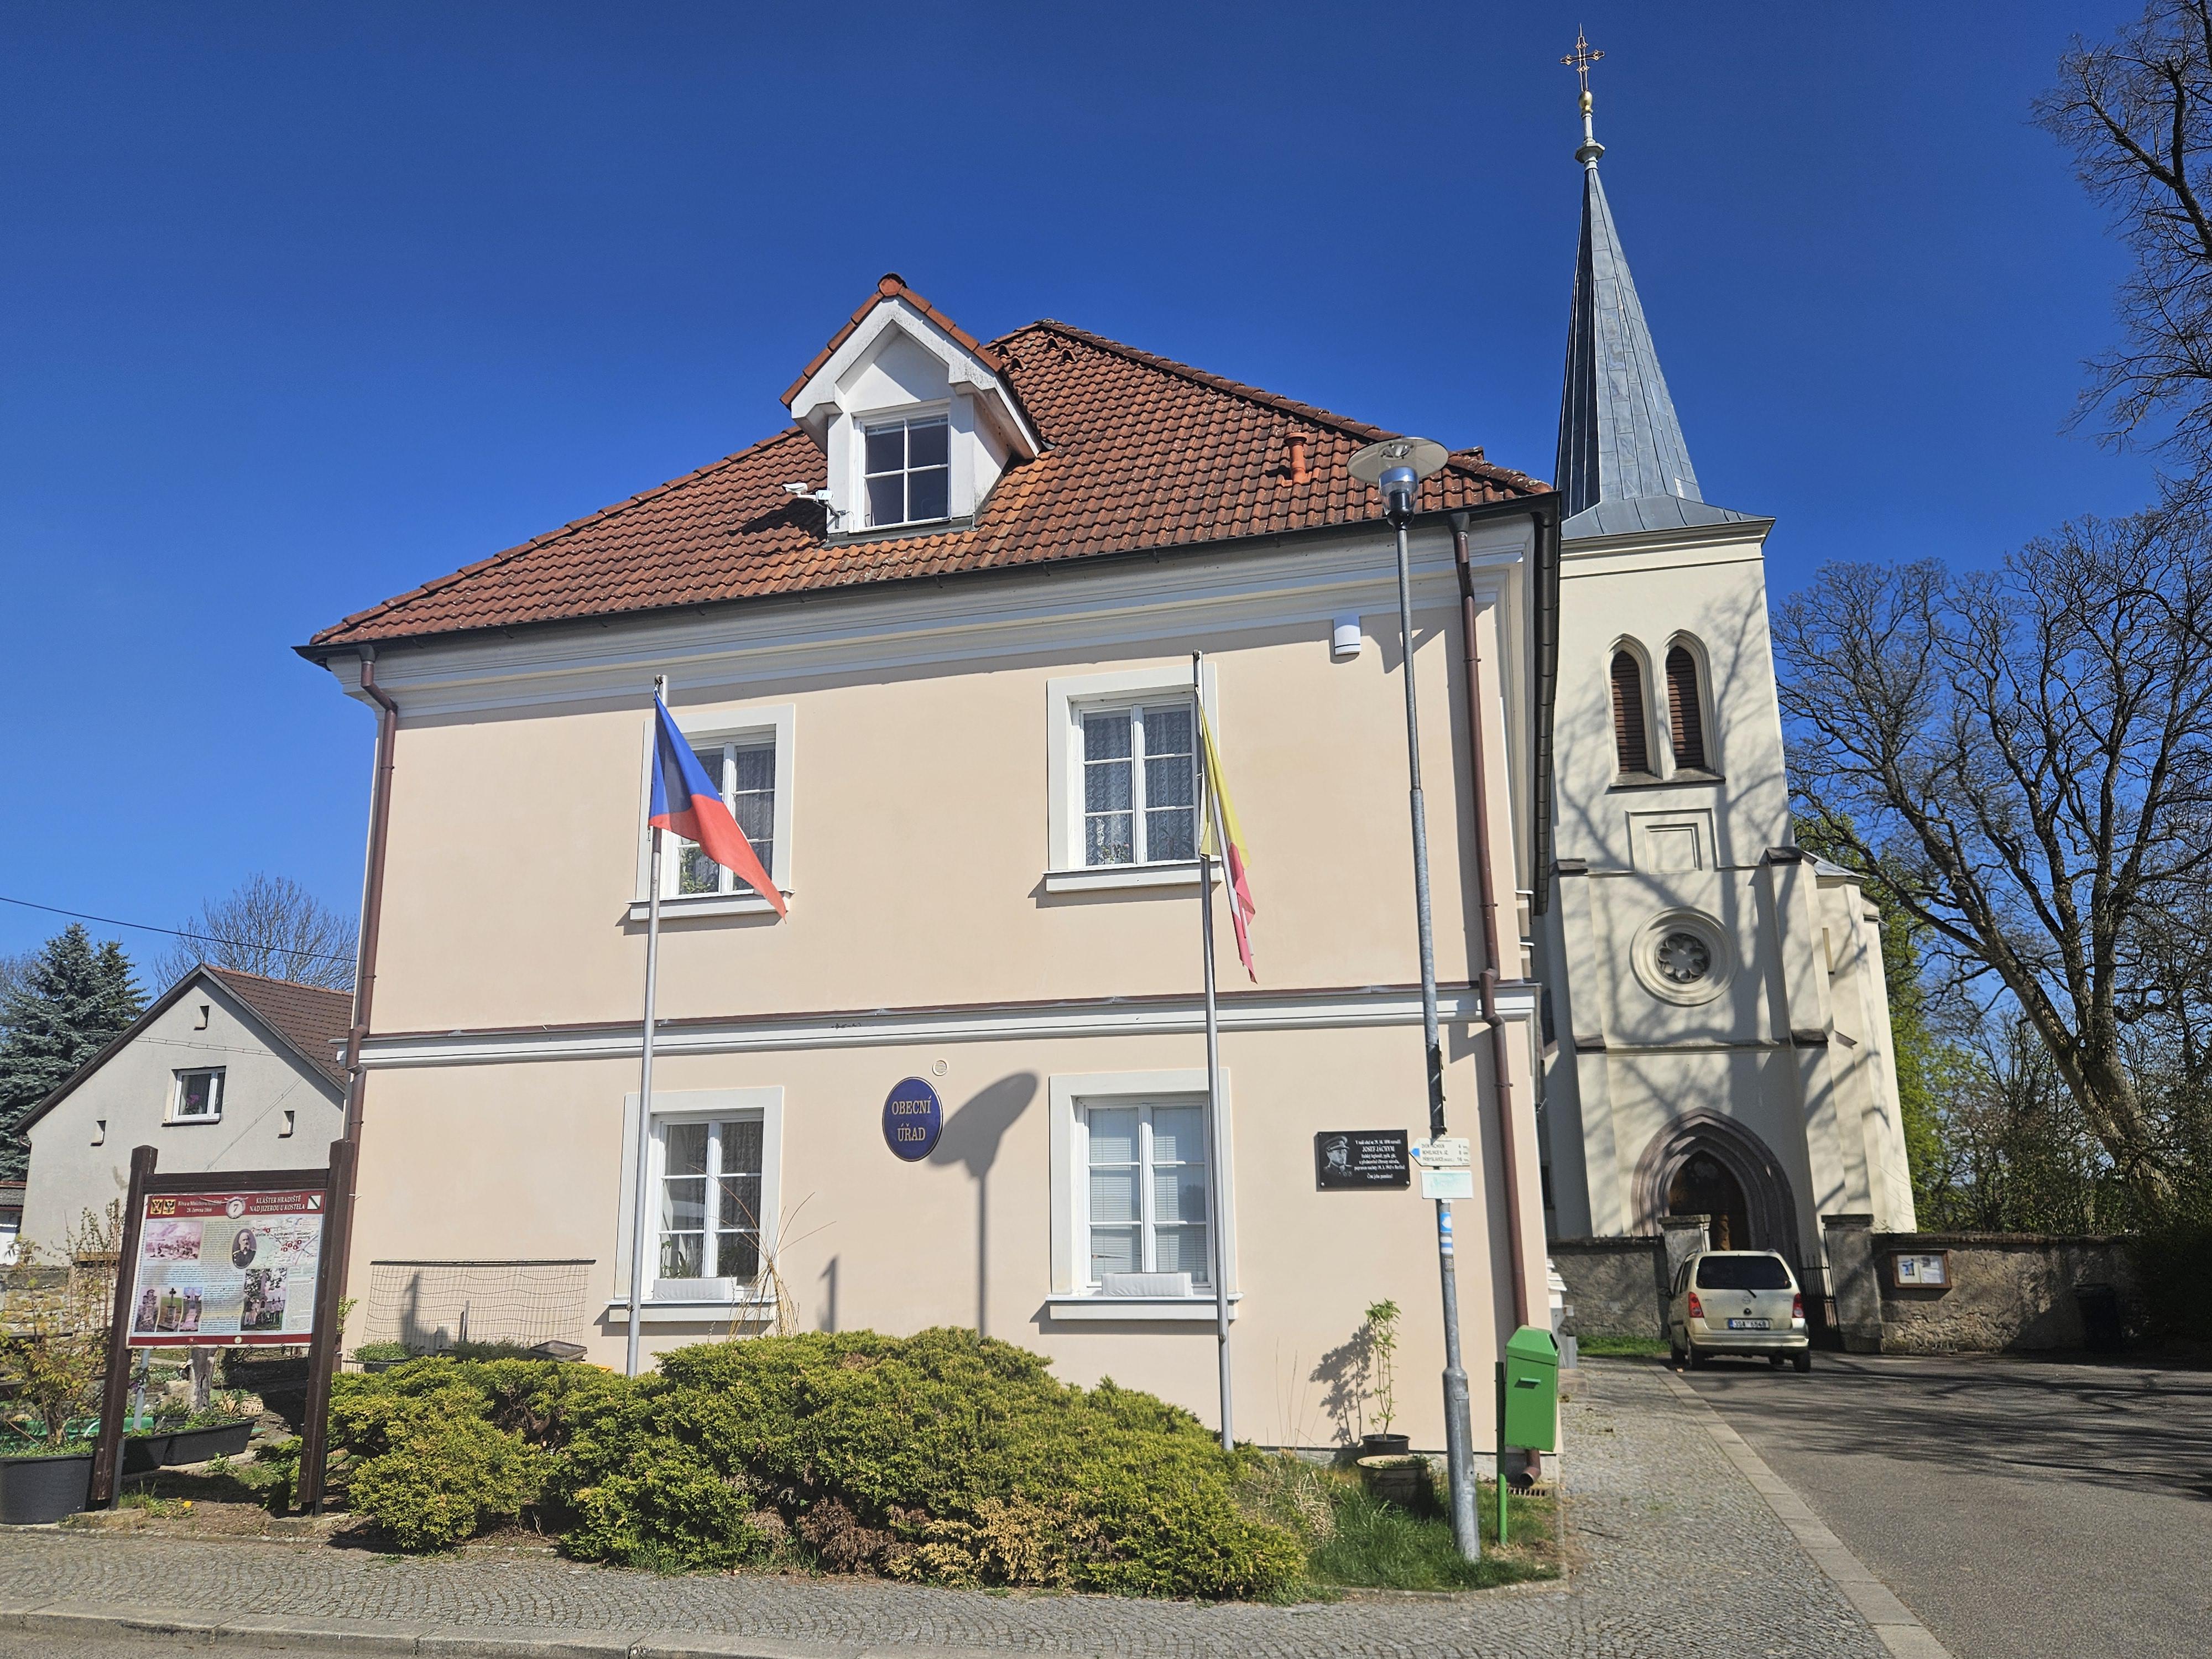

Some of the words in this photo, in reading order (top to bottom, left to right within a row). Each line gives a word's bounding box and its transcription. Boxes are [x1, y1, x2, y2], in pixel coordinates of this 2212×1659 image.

[892, 1095, 932, 1115] OBECNÍ
[897, 1123, 926, 1142] ÚŘAD
[278, 1194, 301, 1203] HRADIŠTĚ
[233, 1204, 239, 1213] 7
